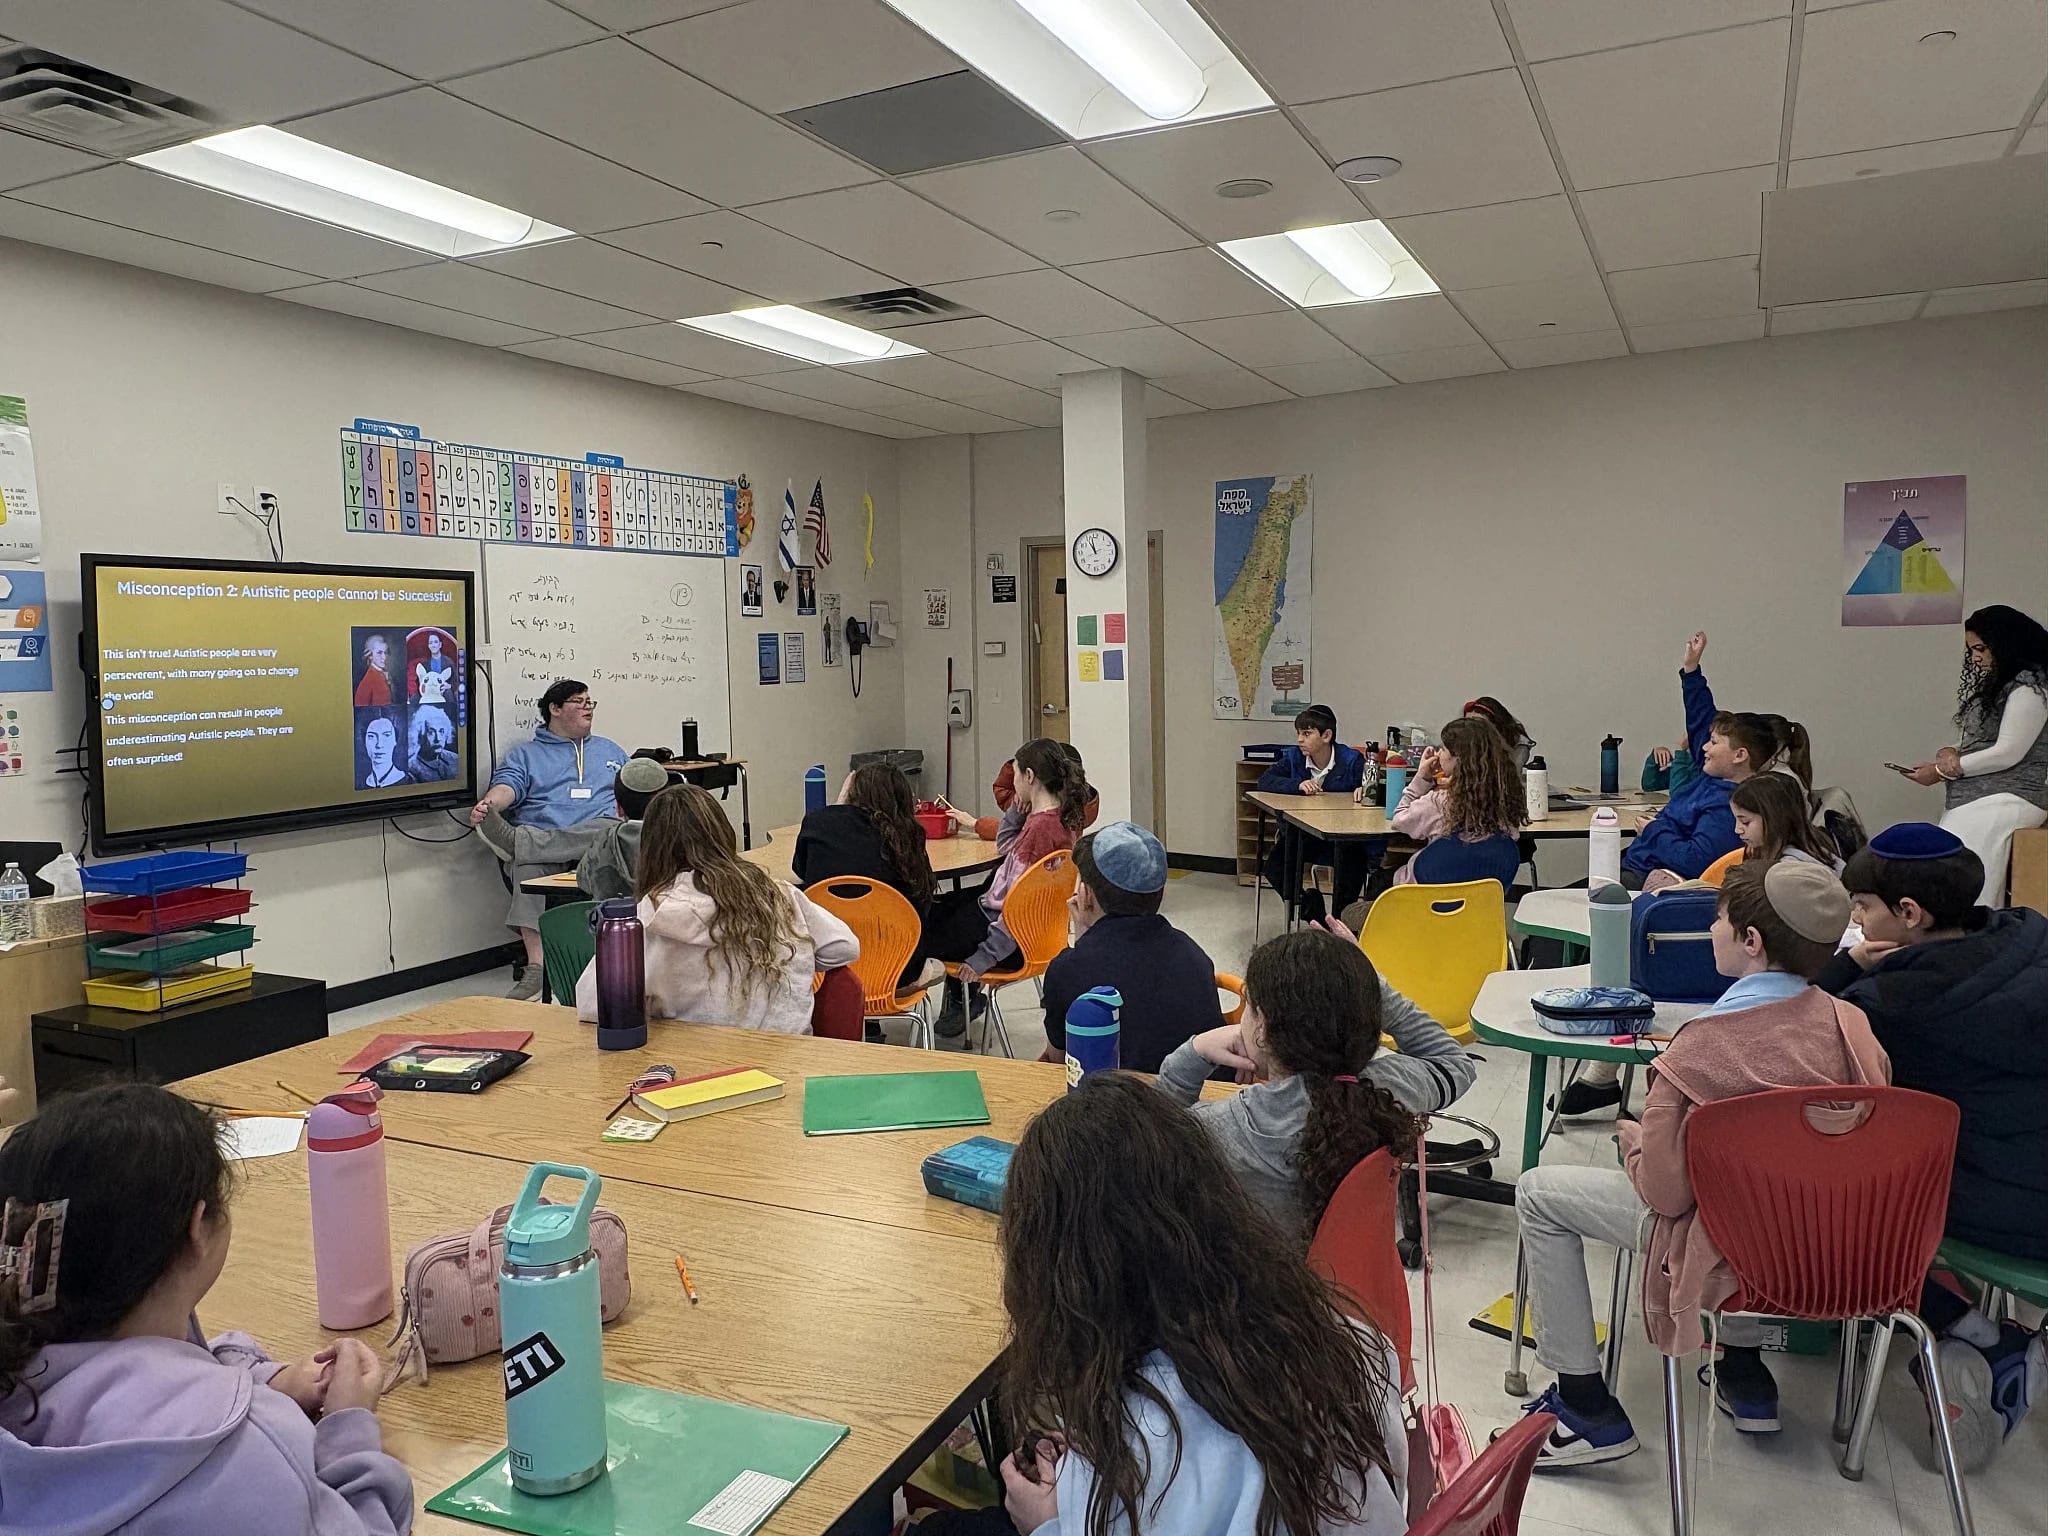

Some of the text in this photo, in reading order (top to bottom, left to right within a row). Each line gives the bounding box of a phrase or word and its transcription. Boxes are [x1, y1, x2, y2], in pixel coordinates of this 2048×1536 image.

[117, 581, 452, 602] Misconception 2: Autistic people Cannot be Successful
[103, 648, 278, 659] This isn't true! Autistic people are very
[104, 670, 166, 682] perseverent,
[167, 669, 188, 678] with
[189, 670, 216, 680] many
[217, 668, 243, 679] going
[257, 668, 267, 676] to
[268, 667, 299, 676] change
[124, 690, 154, 700] world!
[105, 707, 283, 725] This misconception can result in people
[106, 726, 294, 746] underestimating Autistic people. They are
[107, 752, 183, 767] often surprised!
[504, 1342, 555, 1390] ETI
